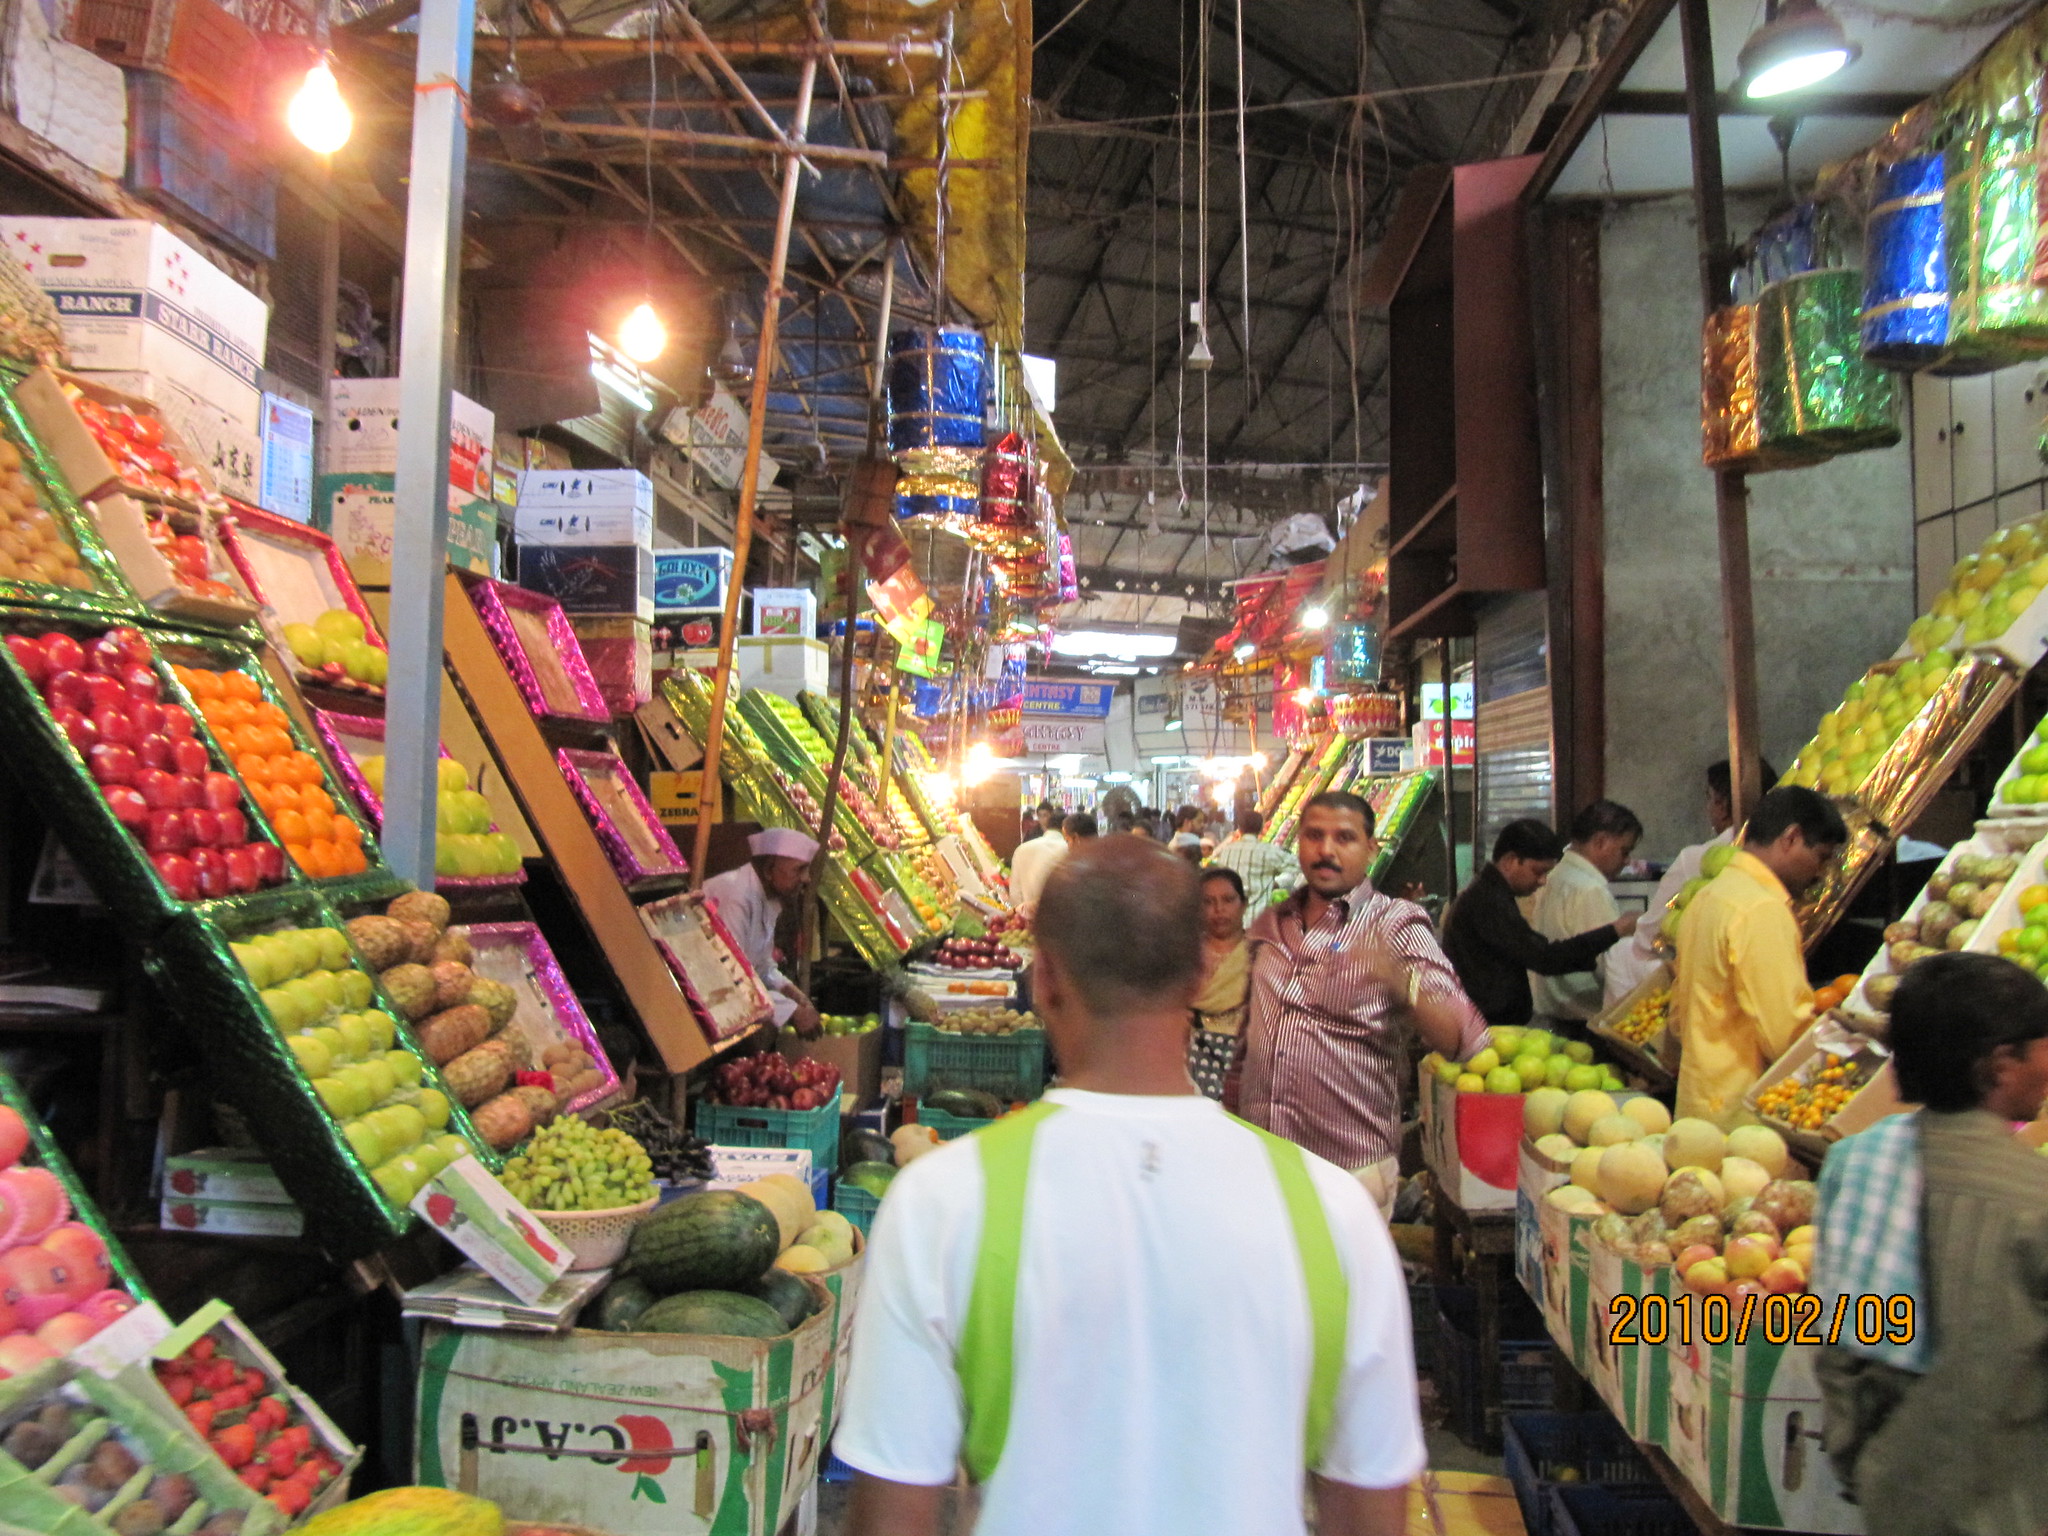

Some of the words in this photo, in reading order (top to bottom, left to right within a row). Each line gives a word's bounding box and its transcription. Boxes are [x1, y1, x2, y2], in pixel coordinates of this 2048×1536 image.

[60, 295, 132, 313] RANCH
[158, 302, 210, 354] STARR
[211, 336, 257, 385] RANCH
[658, 560, 706, 577] GALAXY
[1023, 700, 1060, 711] CENTRE
[660, 807, 700, 817] ZEBRA
[628, 1385, 659, 1398] NEW
